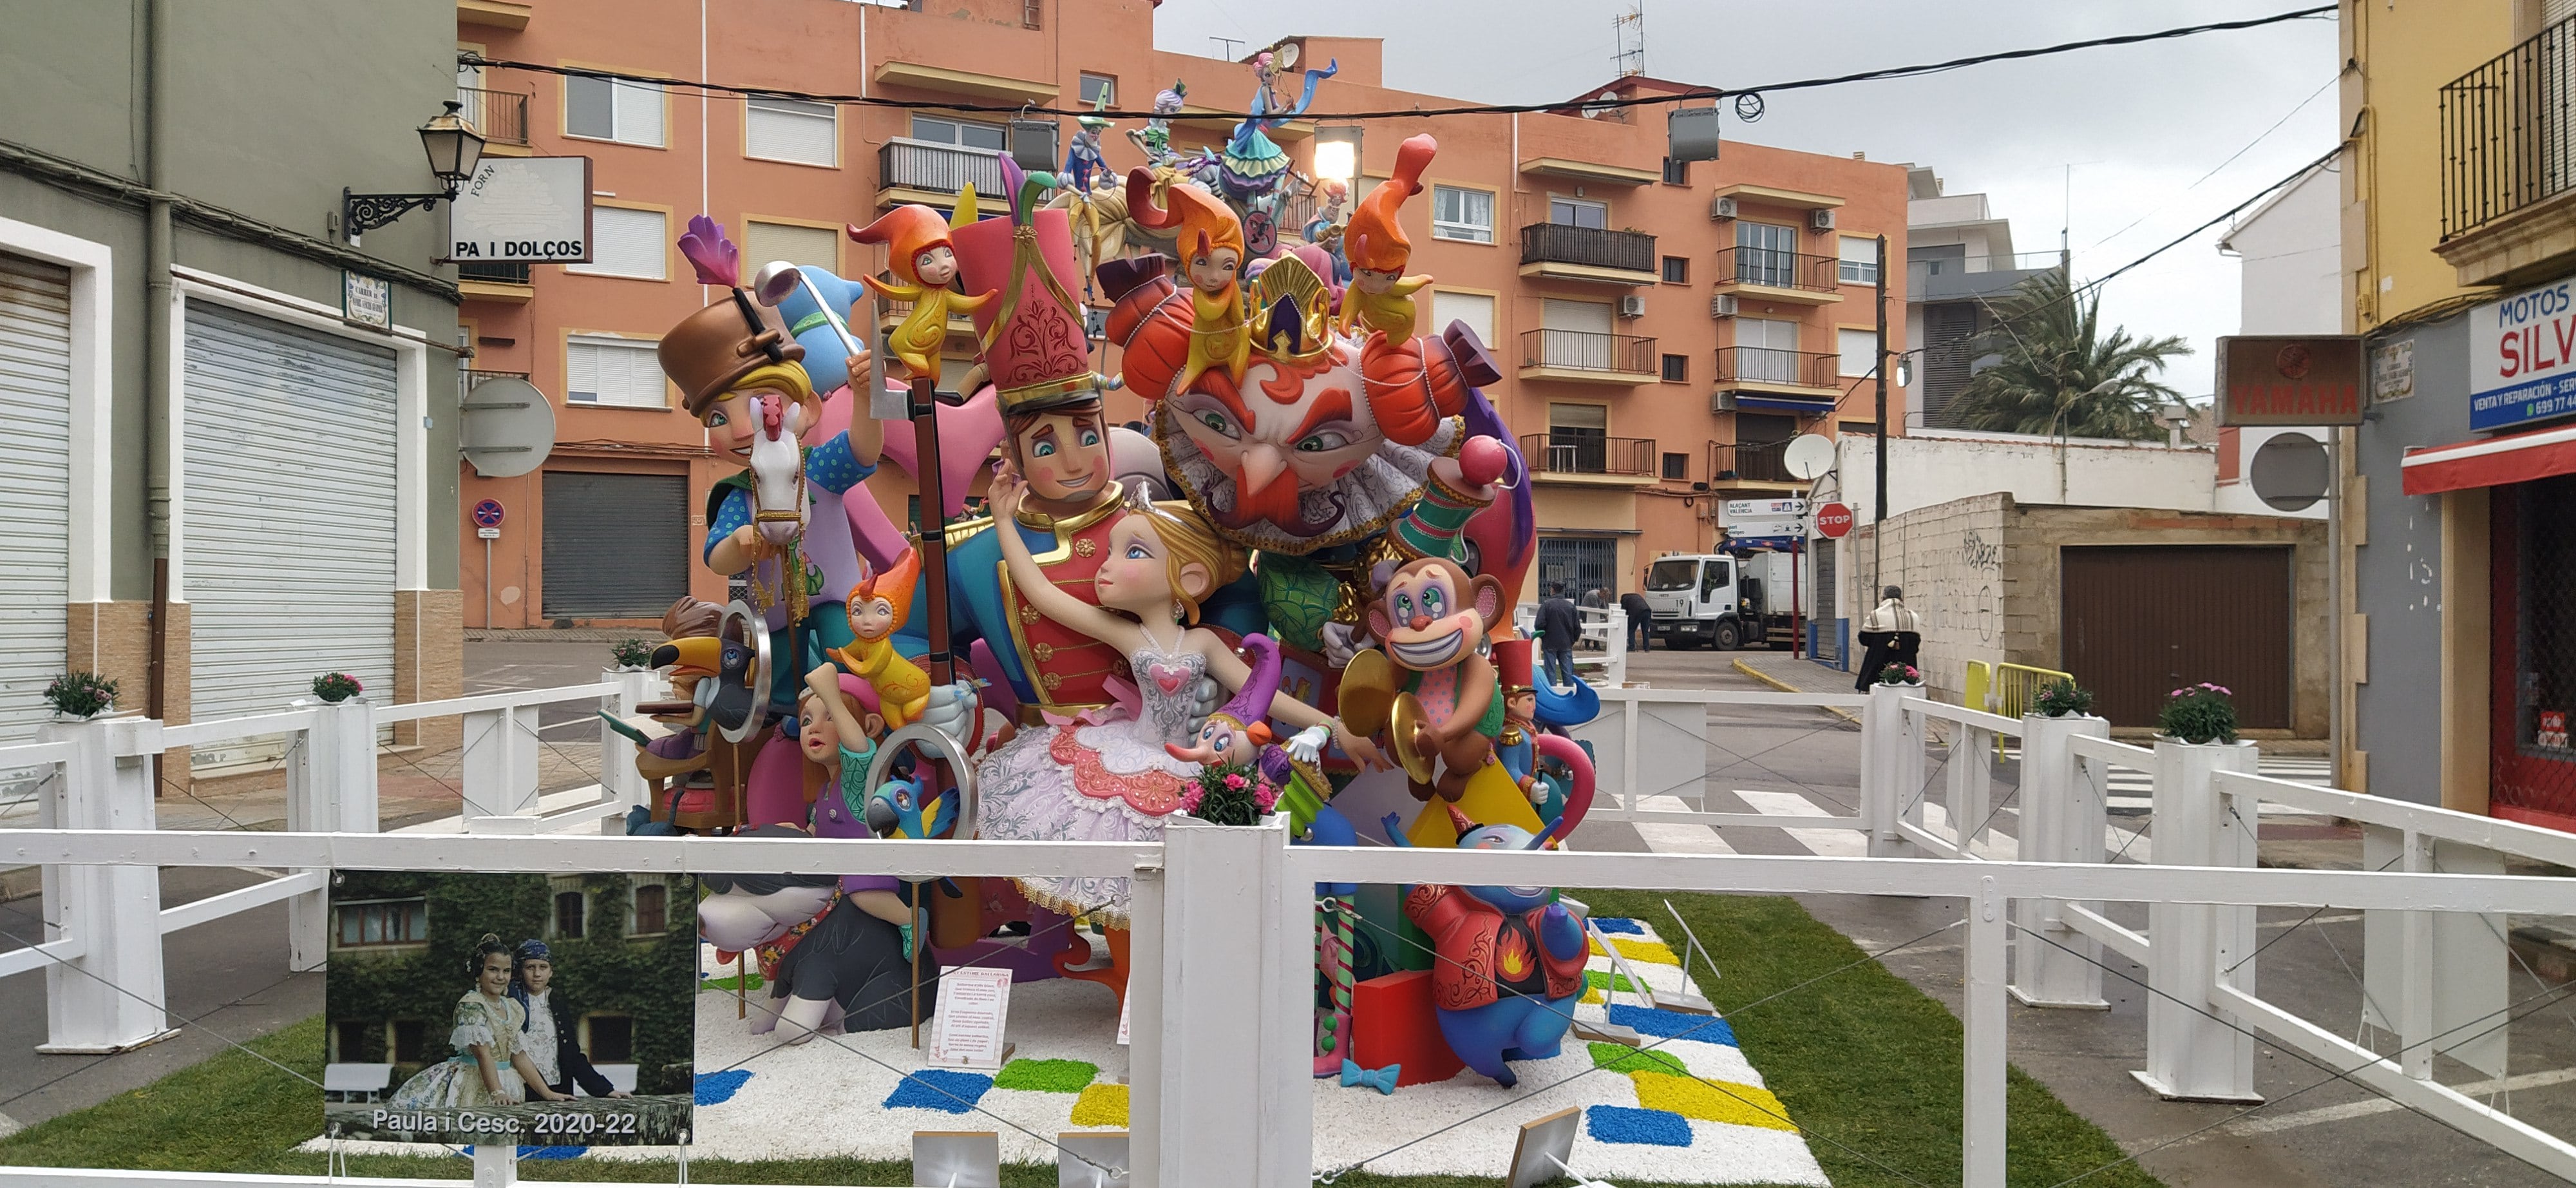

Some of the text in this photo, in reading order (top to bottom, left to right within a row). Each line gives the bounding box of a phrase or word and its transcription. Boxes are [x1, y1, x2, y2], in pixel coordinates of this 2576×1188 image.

[471, 165, 495, 197] FORN
[456, 240, 582, 260] PA I DOLÇOS
[2499, 283, 2570, 329] MOTOS
[2499, 314, 2576, 379] SILV
[2231, 384, 2358, 415] YAMAHA
[2474, 396, 2497, 412] VENTA
[2497, 395, 2503, 407] Y
[2503, 381, 2552, 405] REPARACIÓN
[2559, 378, 2576, 394] SER
[2535, 399, 2553, 416] 699
[2555, 396, 2566, 412] 77
[1819, 515, 1850, 525] STOP
[373, 1109, 636, 1135] Paula i Cesc. 2020-22
